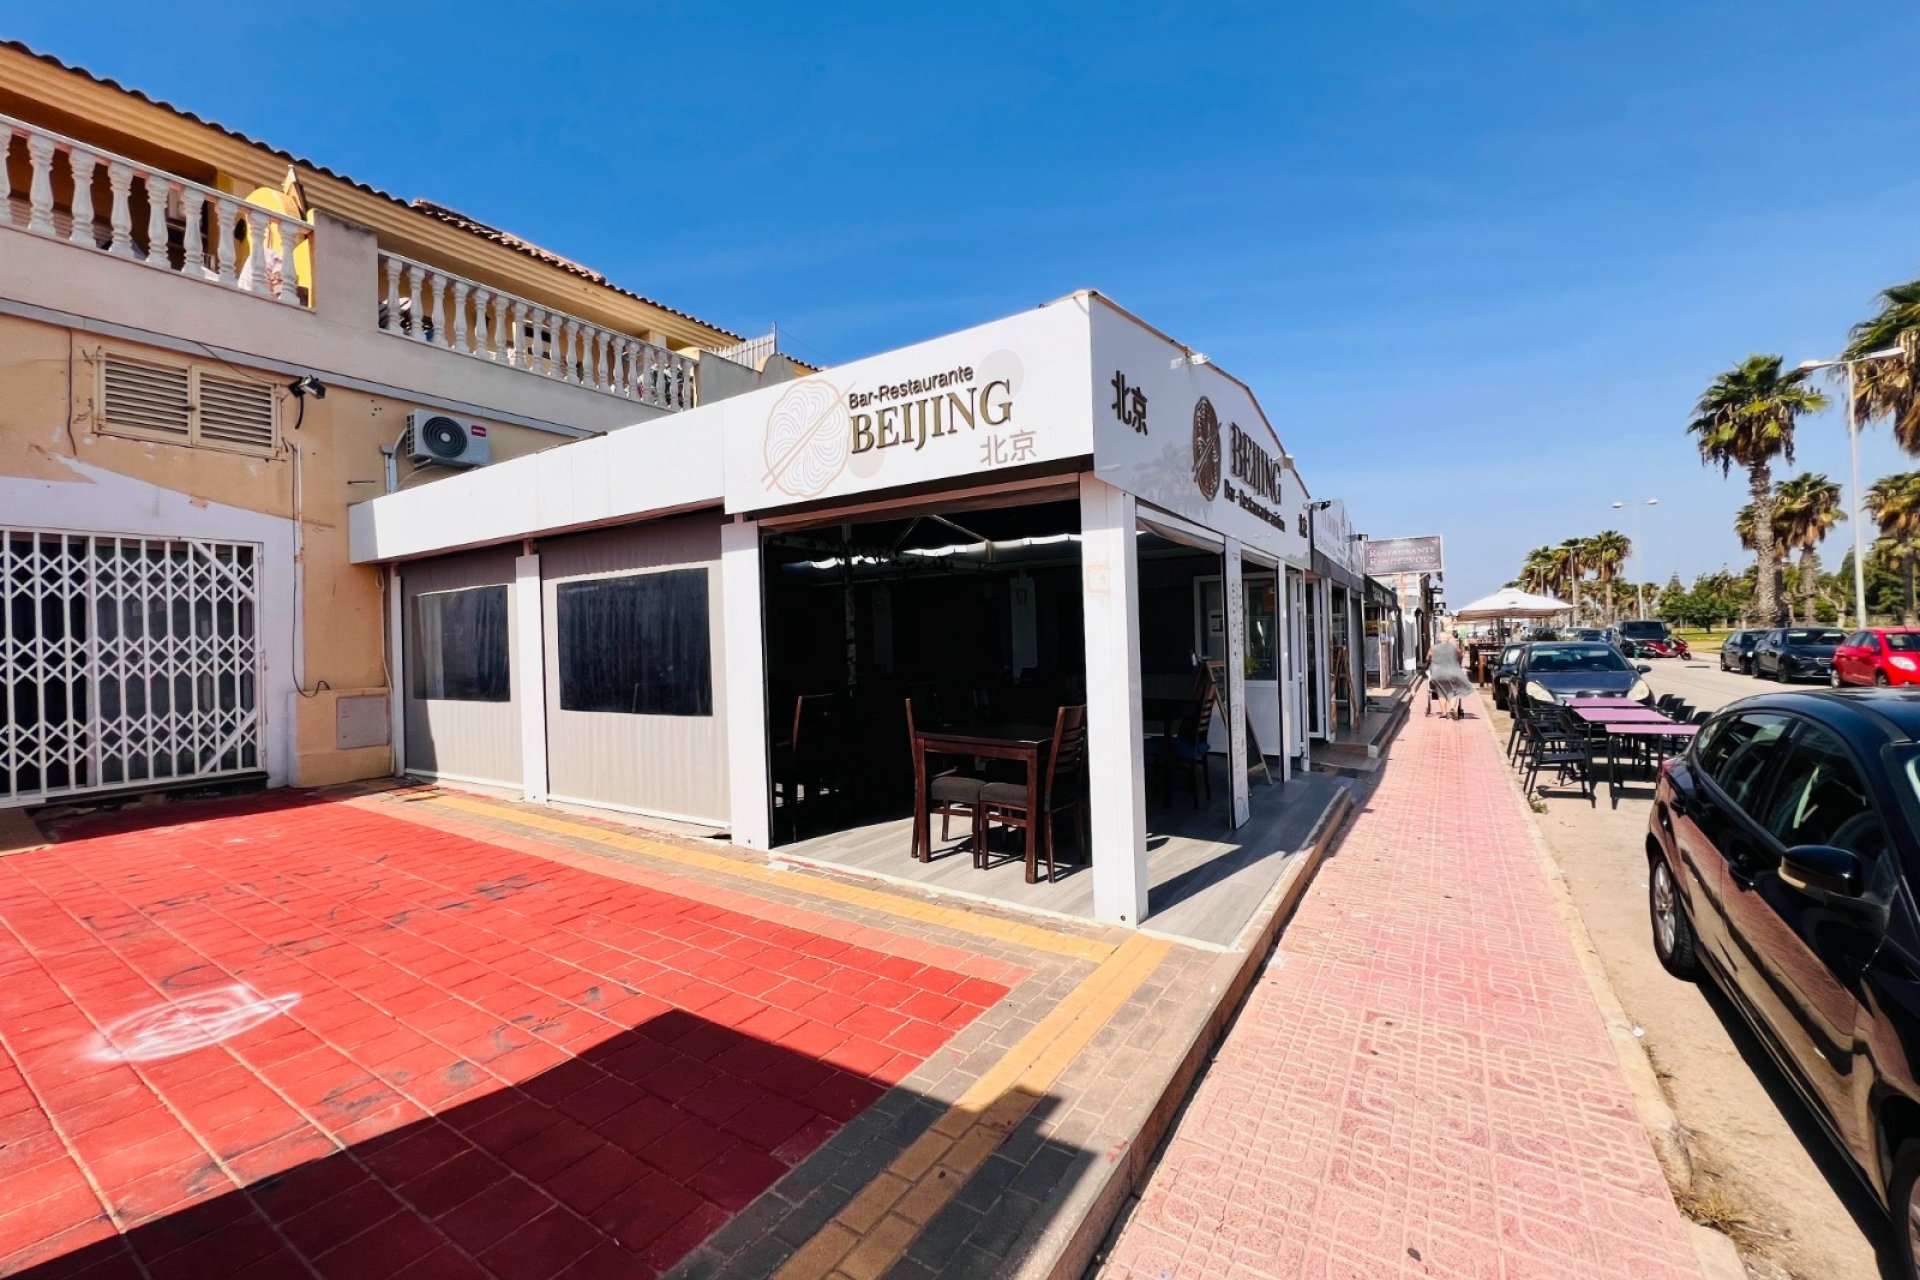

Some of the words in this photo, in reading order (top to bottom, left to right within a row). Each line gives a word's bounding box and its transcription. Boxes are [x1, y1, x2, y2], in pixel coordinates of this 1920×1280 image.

[849, 365, 974, 409] Bar-Restaurante
[850, 379, 1012, 454] BEIJING
[1110, 369, 1148, 436] 北京
[980, 429, 1037, 466] 北京
[1229, 421, 1281, 505] BEIJING
